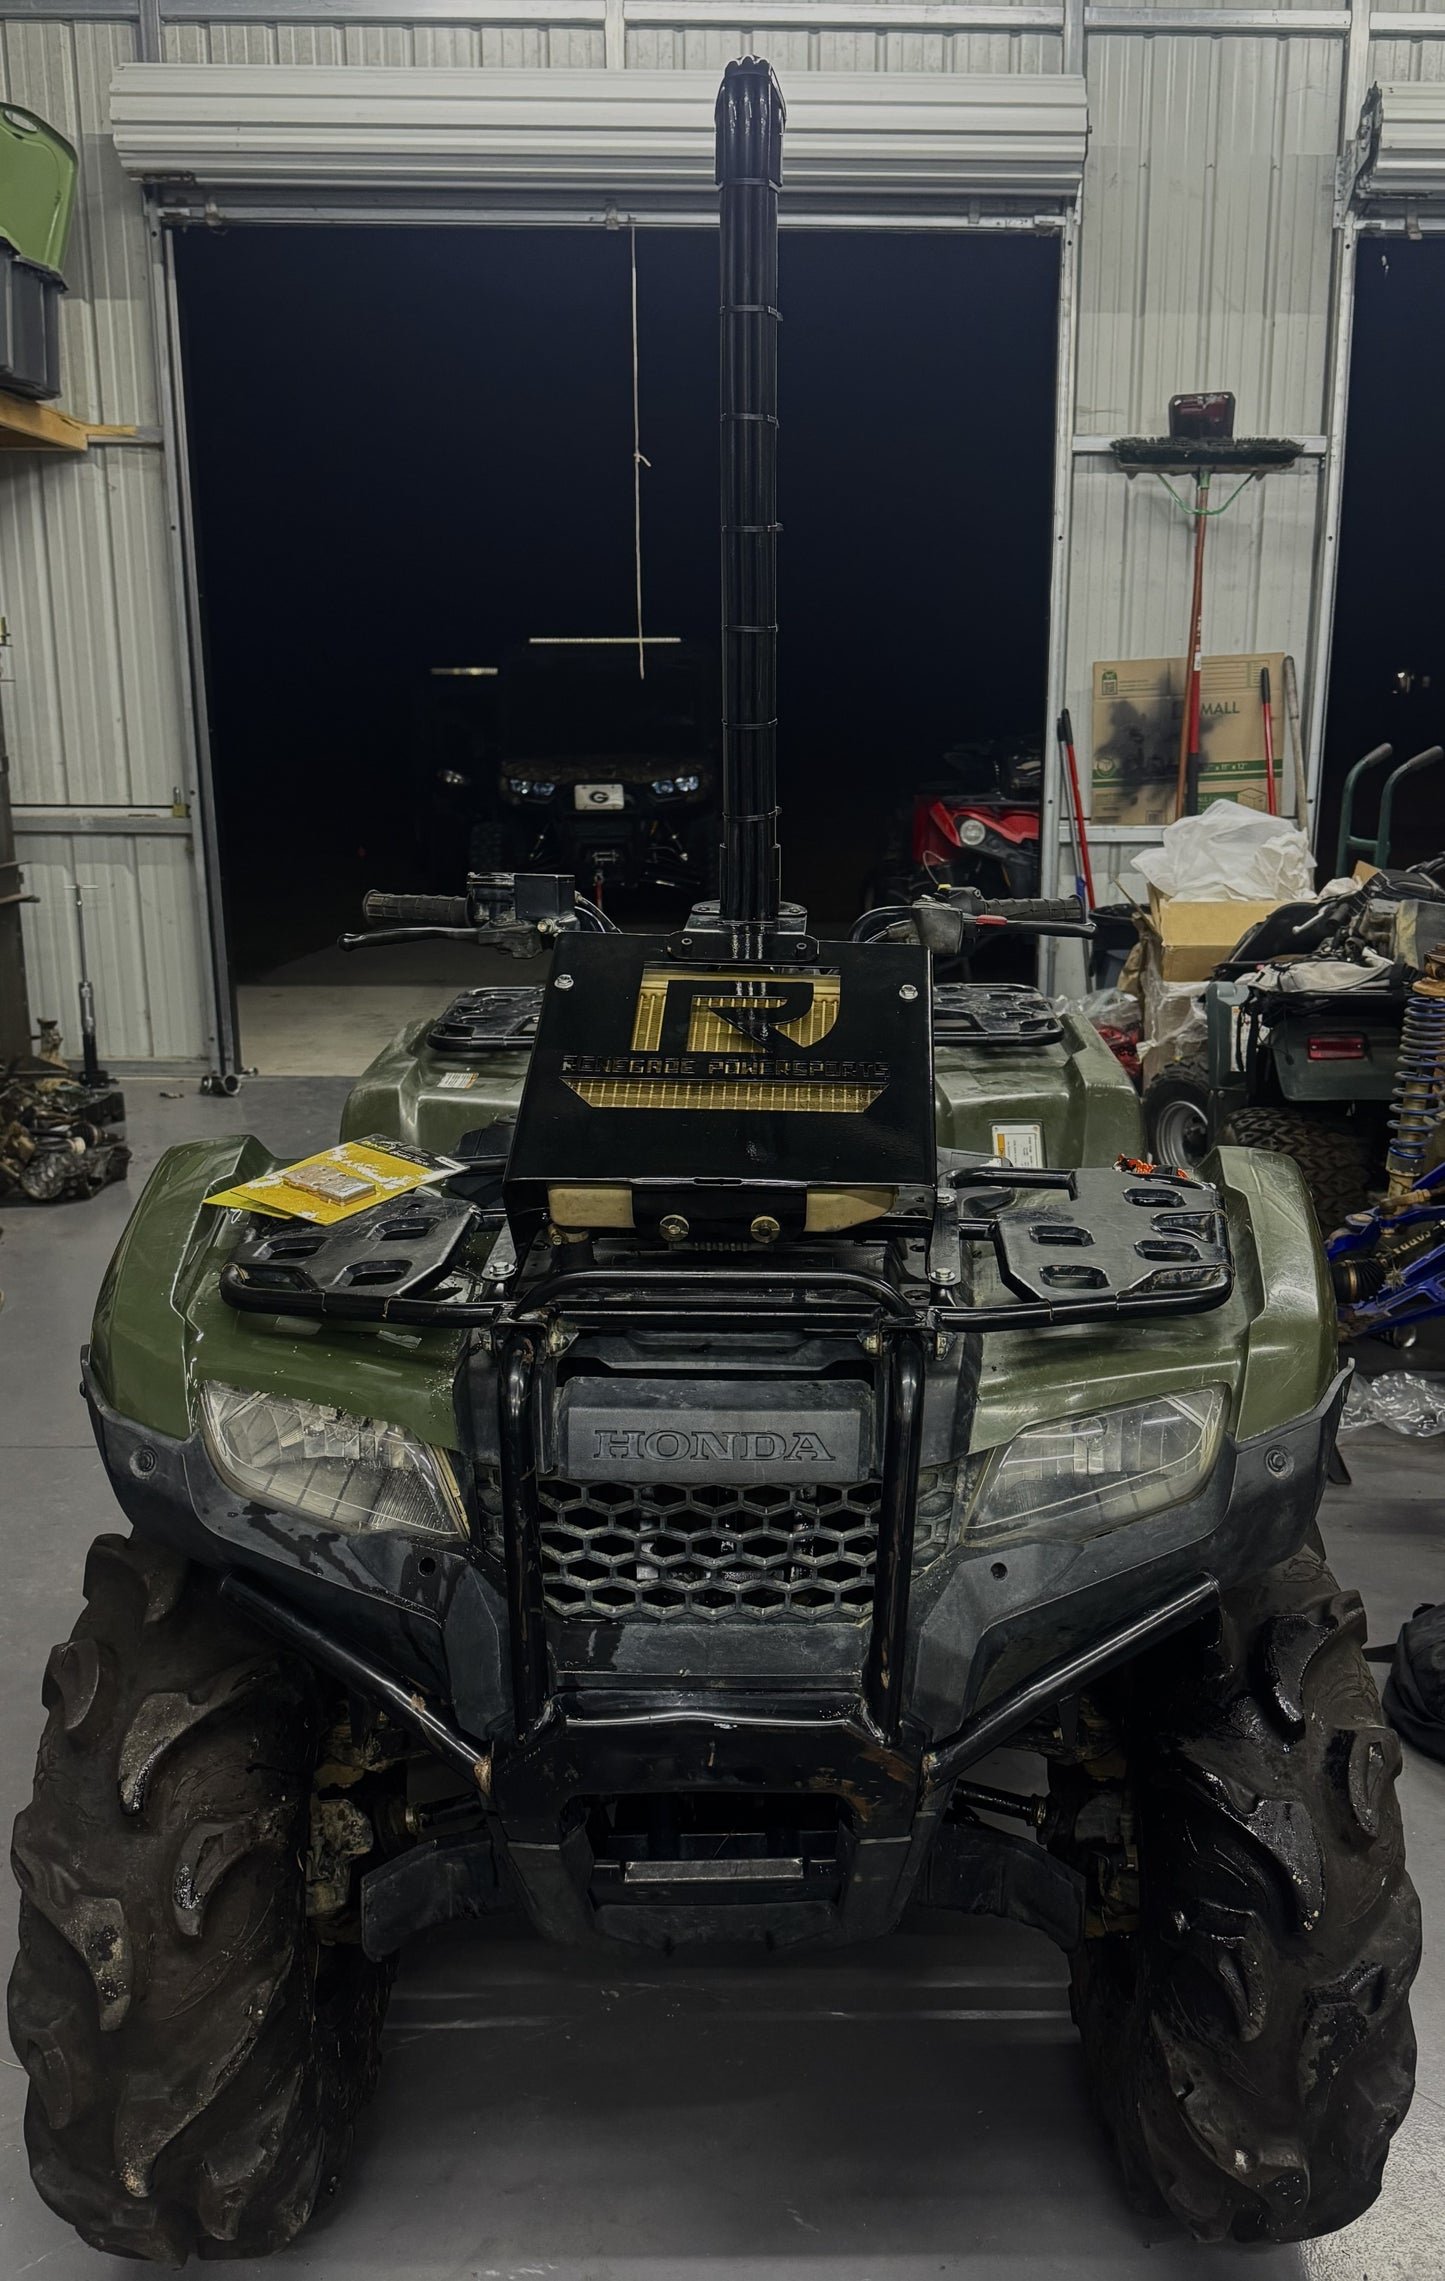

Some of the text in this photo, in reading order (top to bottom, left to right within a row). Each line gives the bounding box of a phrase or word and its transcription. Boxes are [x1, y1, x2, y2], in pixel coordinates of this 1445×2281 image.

[1200, 701, 1240, 715] MALL
[589, 791, 609, 804] G
[562, 1055, 890, 1078] RENEGADE POWERSPORTS
[592, 1429, 836, 1461] HONDA
